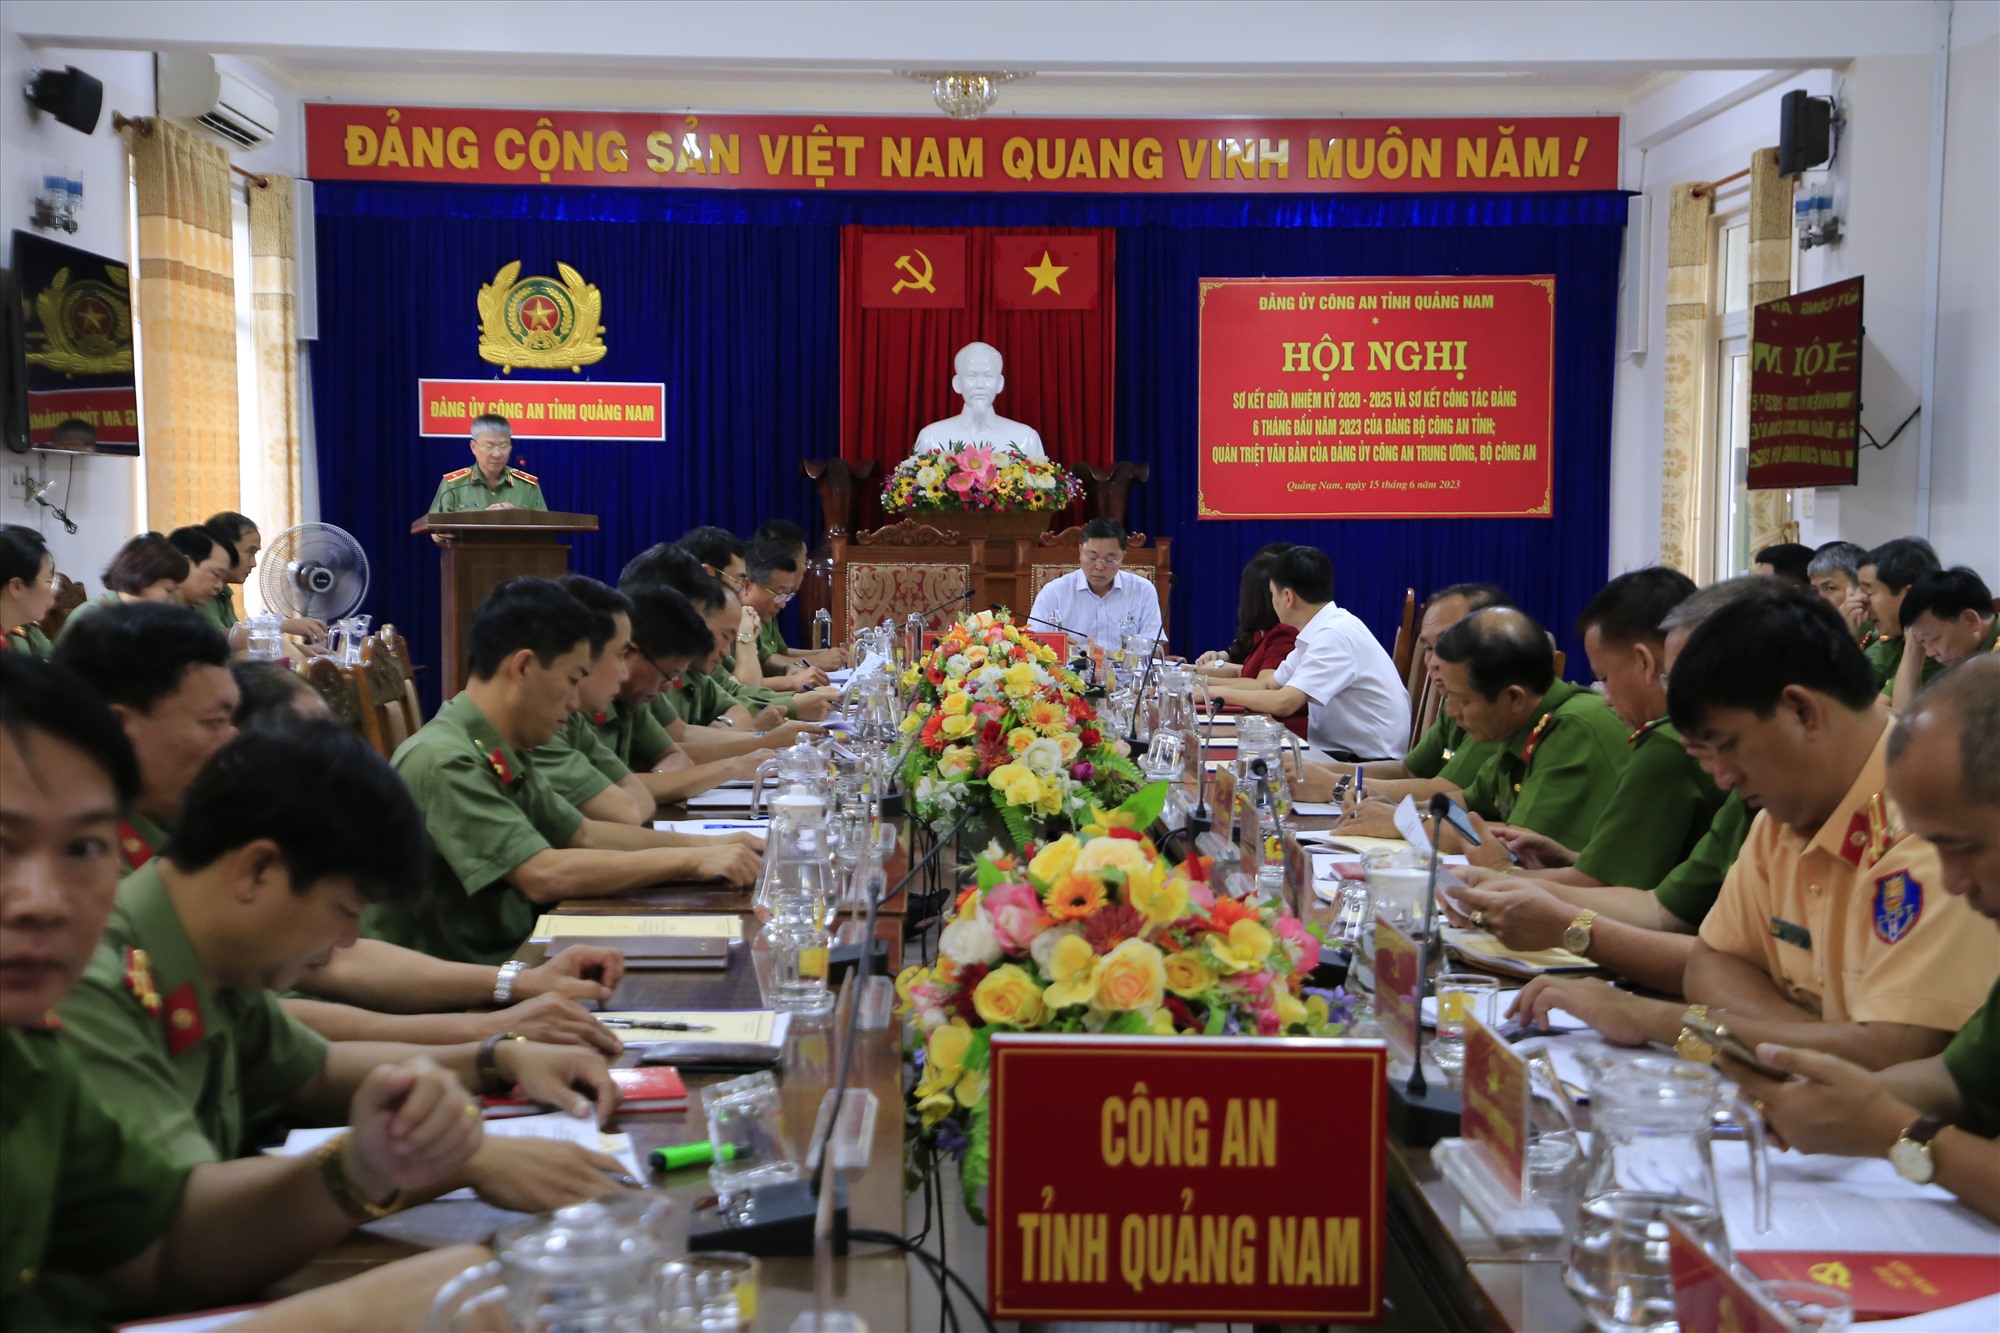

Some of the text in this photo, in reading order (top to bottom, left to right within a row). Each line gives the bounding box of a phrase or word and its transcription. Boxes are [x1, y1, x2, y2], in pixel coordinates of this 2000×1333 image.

[345, 108, 480, 170] ĐẢNG
[494, 118, 629, 183] CỘNG
[646, 116, 740, 174] SẢN
[758, 124, 865, 188] VIỆT
[881, 136, 984, 178] NAM
[1002, 136, 1164, 182] QUANG
[1177, 137, 1290, 179] VINH
[1307, 126, 1442, 179] MUÔN
[1456, 124, 1560, 178] NĂM
[1258, 290, 1495, 311] ĐẢNG ỦY CÔNG AN TỈNH QUẢNG NAM
[1281, 332, 1468, 382] HỘI NGHỊ
[430, 395, 467, 419] ĐẢNG
[487, 398, 525, 420] CÔNG
[525, 402, 545, 420] AN
[546, 397, 577, 421] TỈNH
[579, 398, 623, 422] QUẢNG
[624, 404, 655, 422] NAM
[1232, 391, 1247, 410] SƠ
[1247, 387, 1265, 410] KẾT
[1266, 389, 1290, 409] GIỮA
[1290, 388, 1322, 412] NHIỆM
[1323, 389, 1337, 409] KỲ
[1337, 391, 1361, 409] 2020
[1368, 391, 1393, 408] 2025
[1393, 388, 1407, 408] VÀ
[1408, 389, 1422, 408] SƠ
[1423, 385, 1442, 408] KẾT
[1442, 387, 1469, 408] CÔNG
[1470, 390, 1489, 408] TÁC
[1490, 385, 1517, 408] ĐẢNG
[1252, 412, 1496, 439] 6 THÁNG ĐẦU NĂM 2023 CỦA ĐẢNG BỘ CÔNG AN TỈNH;
[1212, 439, 1537, 467] QUÁN TRIỆT VĂN BẢN CỦA ĐẢNG ỦY CÔNG AN TRUNG ƯƠNG, BỘ CÔNG AN
[1318, 480, 1343, 490] Nam,
[1345, 480, 1367, 491] ngày
[1369, 479, 1380, 489] 15
[1381, 479, 1408, 491] tháng
[1408, 480, 1415, 489] 6
[1417, 480, 1437, 489] năm
[1439, 479, 1461, 489] 2023
[1101, 1081, 1277, 1168] CÔNG AN
[1017, 1185, 1361, 1292] TỈNH QUẢNG NAM
